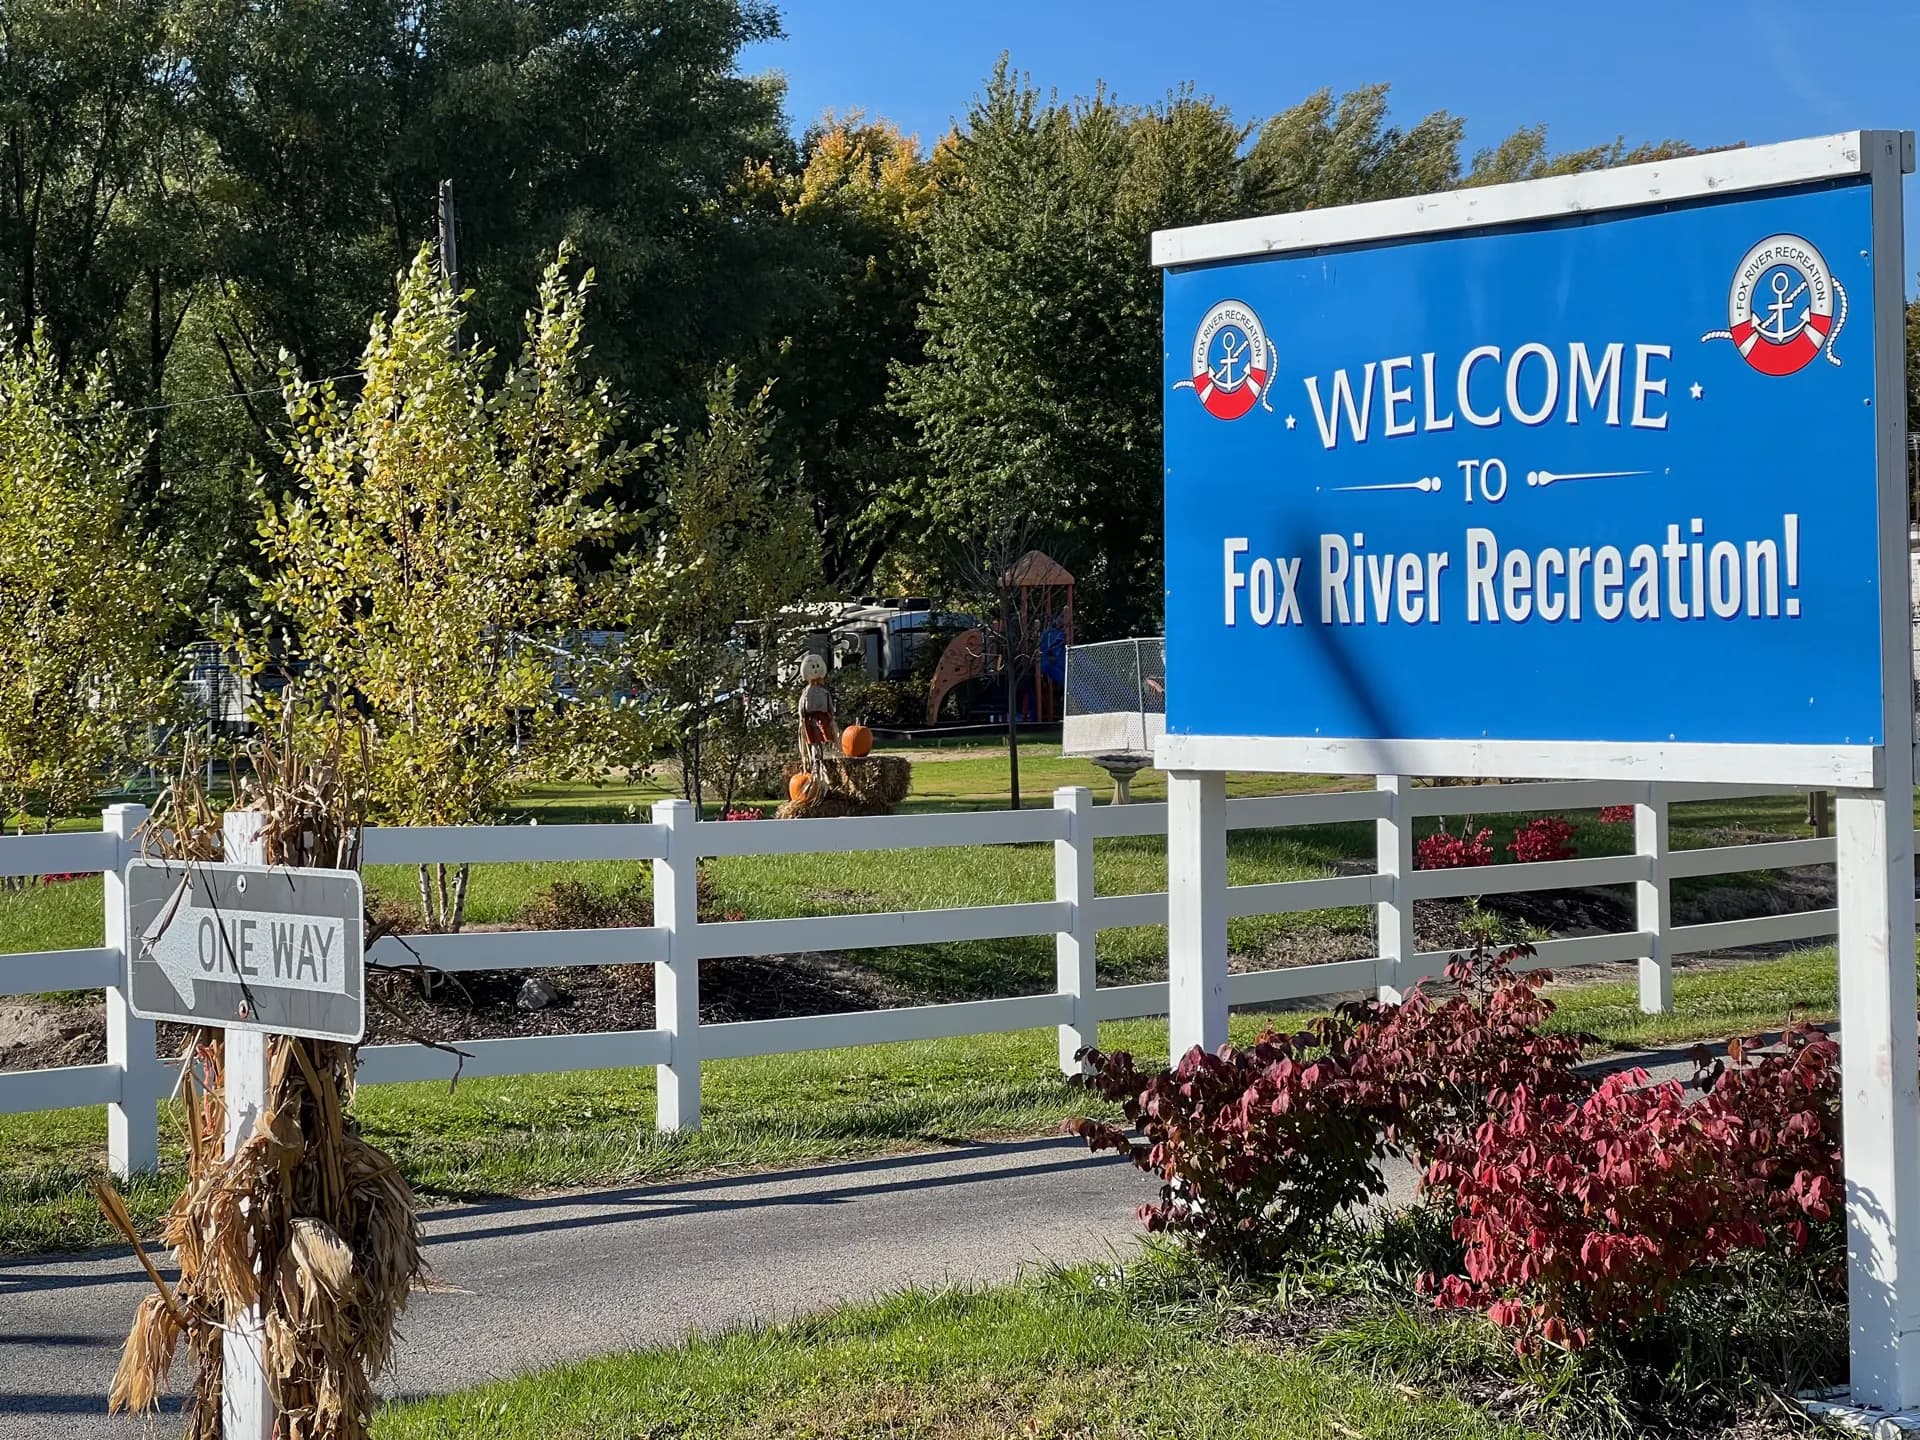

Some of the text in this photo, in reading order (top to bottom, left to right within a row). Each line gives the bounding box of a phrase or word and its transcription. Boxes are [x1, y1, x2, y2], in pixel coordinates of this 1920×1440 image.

[1736, 246, 1827, 310] FOX RIVER RECREATION
[1197, 310, 1262, 363] FOX RIVER RECREATION
[1303, 342, 1671, 450] WELCOME
[1457, 458, 1507, 503] TO
[1224, 513, 1801, 626] Fox River Recreation!
[198, 915, 335, 983] ONE WAY
